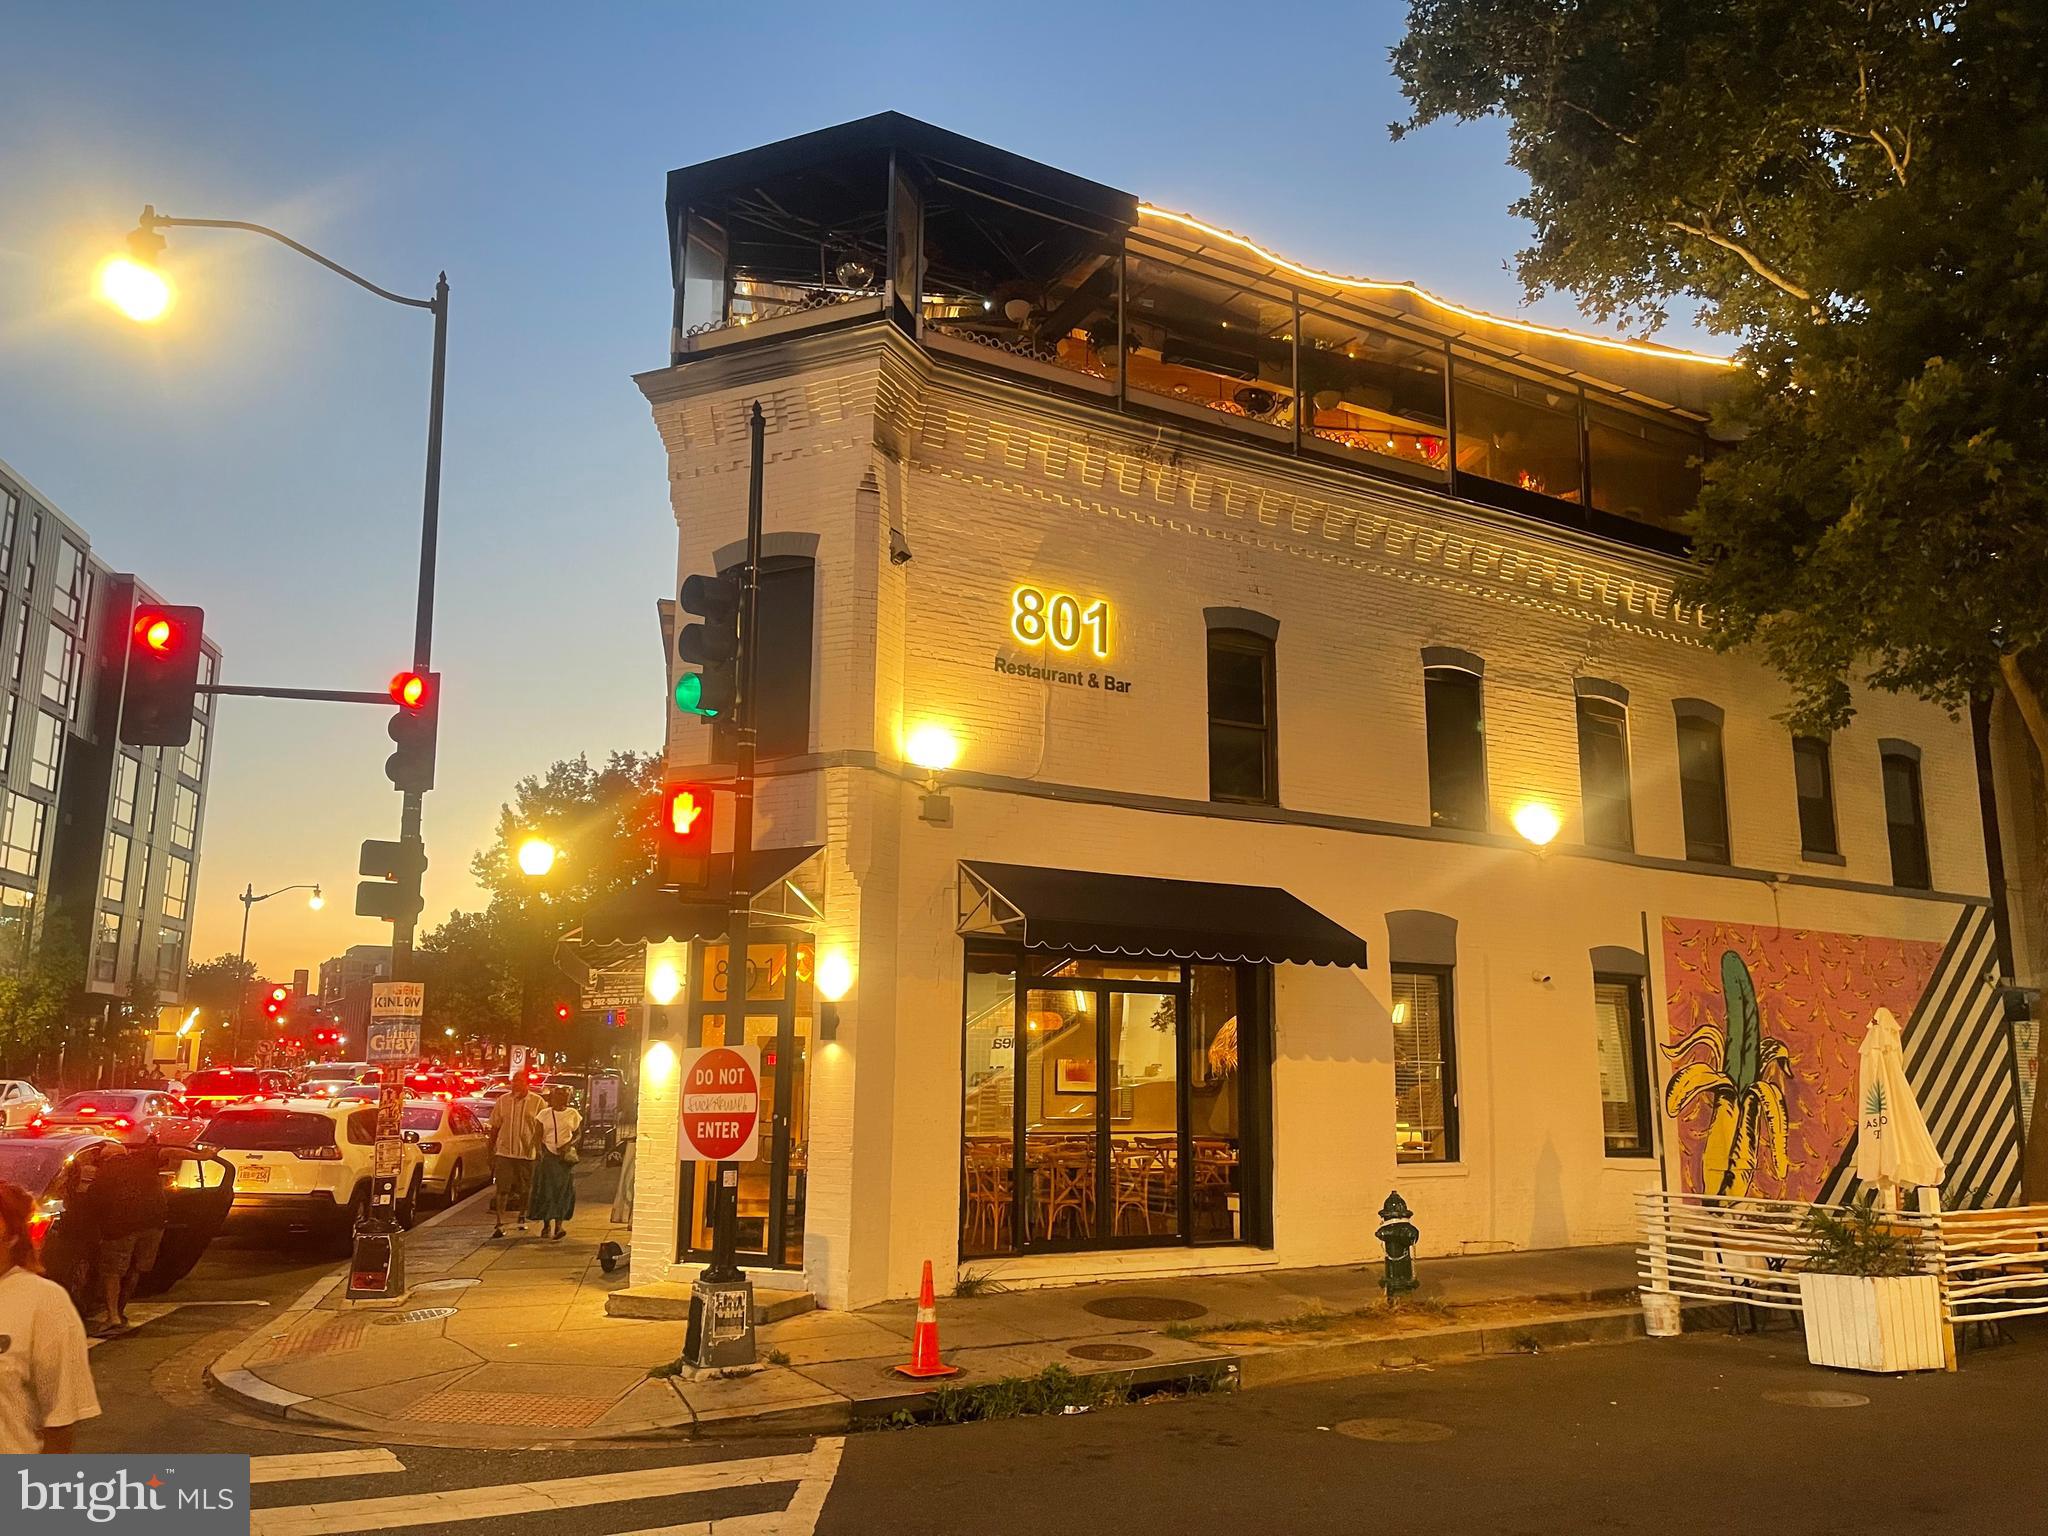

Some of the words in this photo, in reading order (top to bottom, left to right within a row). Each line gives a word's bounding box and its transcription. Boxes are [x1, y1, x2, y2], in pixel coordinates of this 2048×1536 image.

[1013, 586, 1109, 657] 801
[994, 657, 1084, 686] Restaurant
[1087, 673, 1100, 689] &
[1104, 676, 1132, 693] Bar
[374, 996, 422, 1008] KINLOW
[370, 1034, 417, 1054] Gray
[696, 1069, 714, 1085] DO
[719, 1067, 745, 1085] NOT
[696, 1121, 740, 1139] ENTER
[1866, 1115, 1888, 1129] ASO
